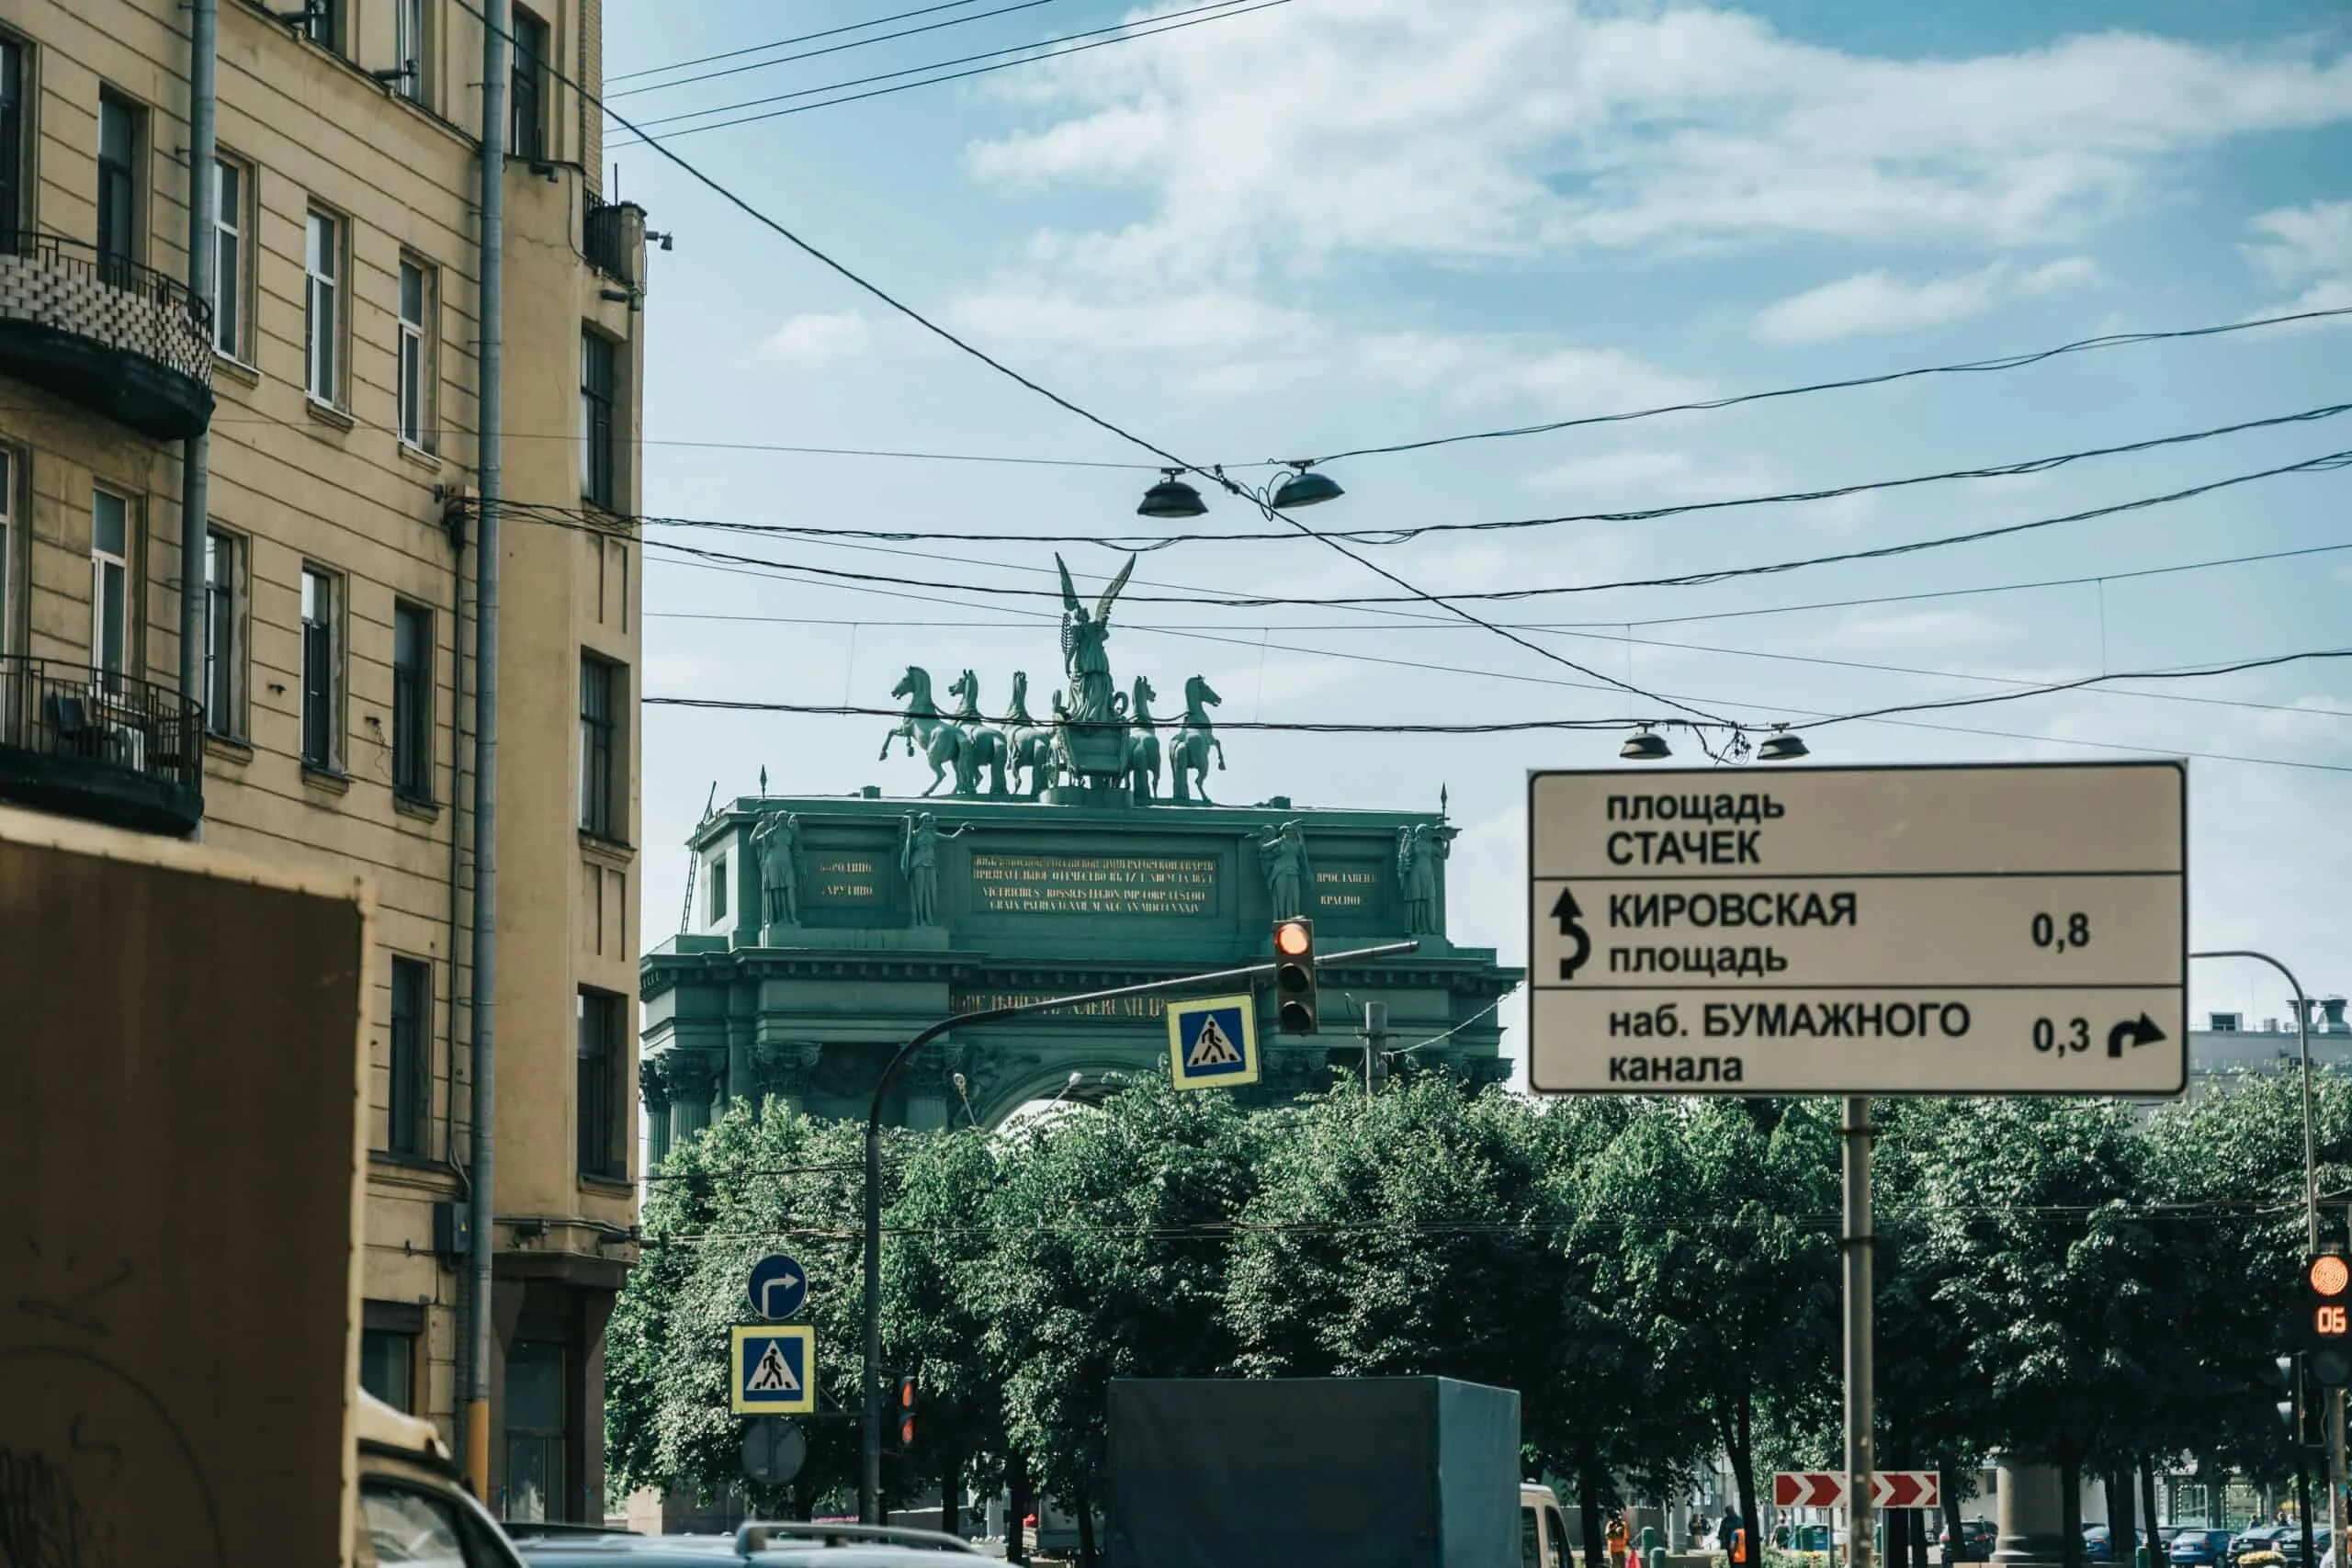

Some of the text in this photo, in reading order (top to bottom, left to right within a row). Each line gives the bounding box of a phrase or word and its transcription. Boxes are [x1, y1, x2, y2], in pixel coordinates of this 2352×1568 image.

[1607, 794, 1785, 825] площадь
[1607, 830, 1760, 865] СТАЧЕК
[1610, 892, 1856, 928] КИРОВСКАЯ
[2031, 912, 2089, 953] 0,8
[1610, 947, 1788, 977] площадь
[1610, 1002, 1970, 1037] наб. БУМАЖНОГО
[2033, 1018, 2090, 1058] 0,3
[1610, 1056, 1742, 1082] канала
[2317, 1305, 2347, 1334] 06
